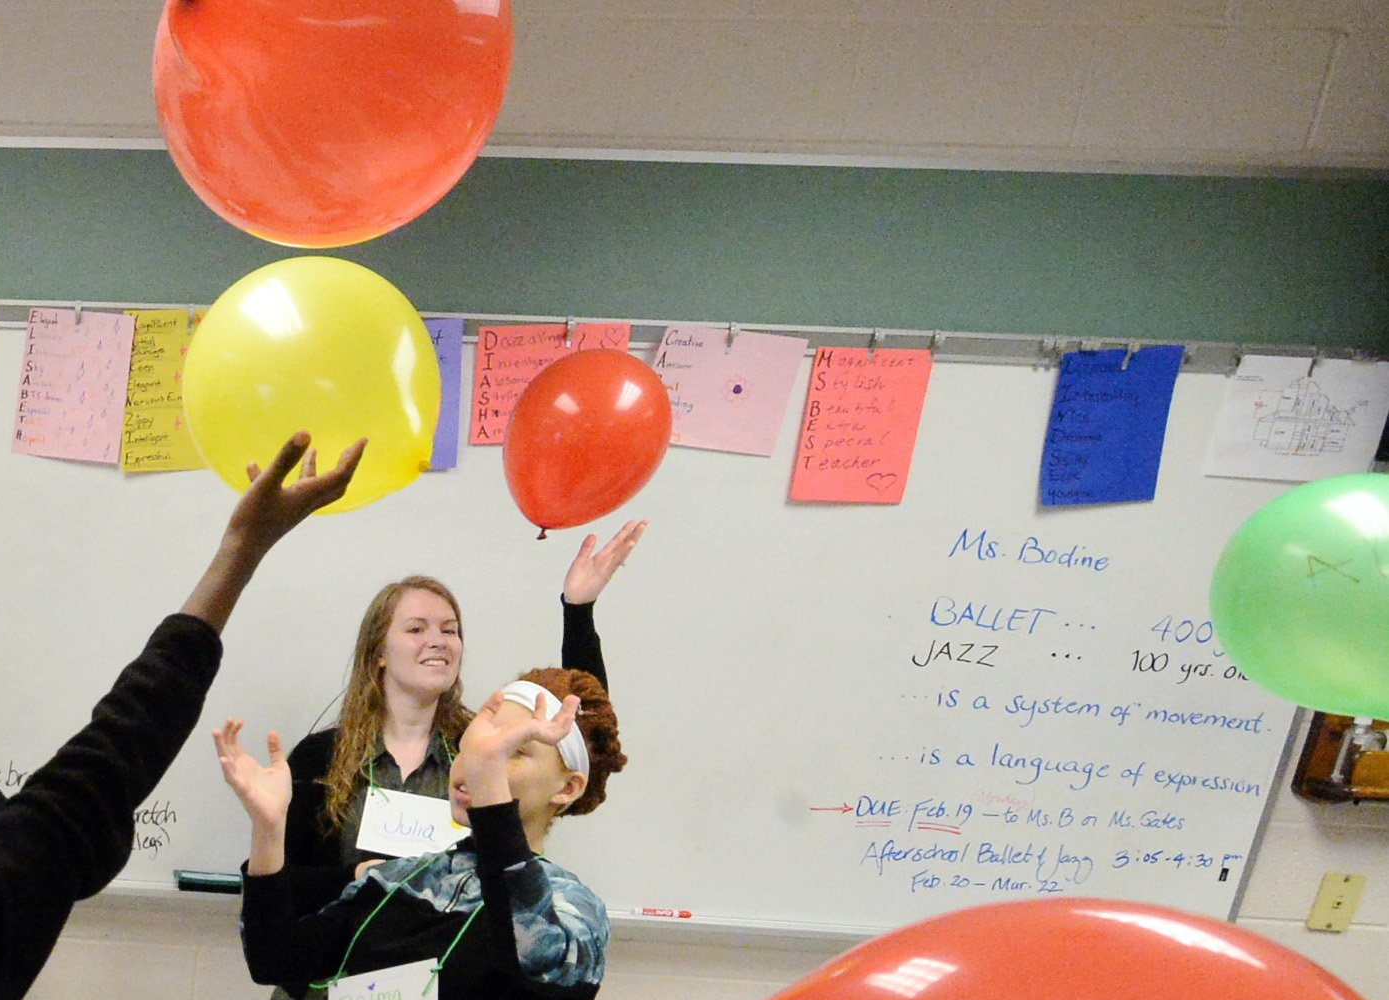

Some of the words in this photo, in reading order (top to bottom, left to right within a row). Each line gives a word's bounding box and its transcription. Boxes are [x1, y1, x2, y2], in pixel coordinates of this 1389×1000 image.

[803, 456, 881, 471] Teacher
[948, 528, 1006, 560] Ms.
[1017, 536, 1111, 571] Bodine
[1150, 615, 1213, 643] 400
[911, 639, 999, 667] JAZZ
[1131, 650, 1169, 672] 100
[1176, 663, 1214, 684] yrs.
[972, 695, 990, 710] a
[1004, 694, 1100, 728] system
[1111, 702, 1131, 726] of
[956, 753, 975, 767] a
[991, 743, 1110, 791] language
[1120, 761, 1146, 787] of
[1154, 769, 1261, 797] expression
[133, 800, 177, 826] retch
[384, 811, 436, 841] Julia
[954, 801, 973, 827] 19
[1002, 807, 1018, 822] to
[1027, 808, 1053, 827] Ms.
[1057, 807, 1074, 828] B
[1139, 810, 1186, 830] Gates
[860, 839, 970, 876] Afterschool
[977, 842, 1033, 866] Ballet
[950, 874, 971, 888] 20
[1038, 880, 1063, 893] 22
